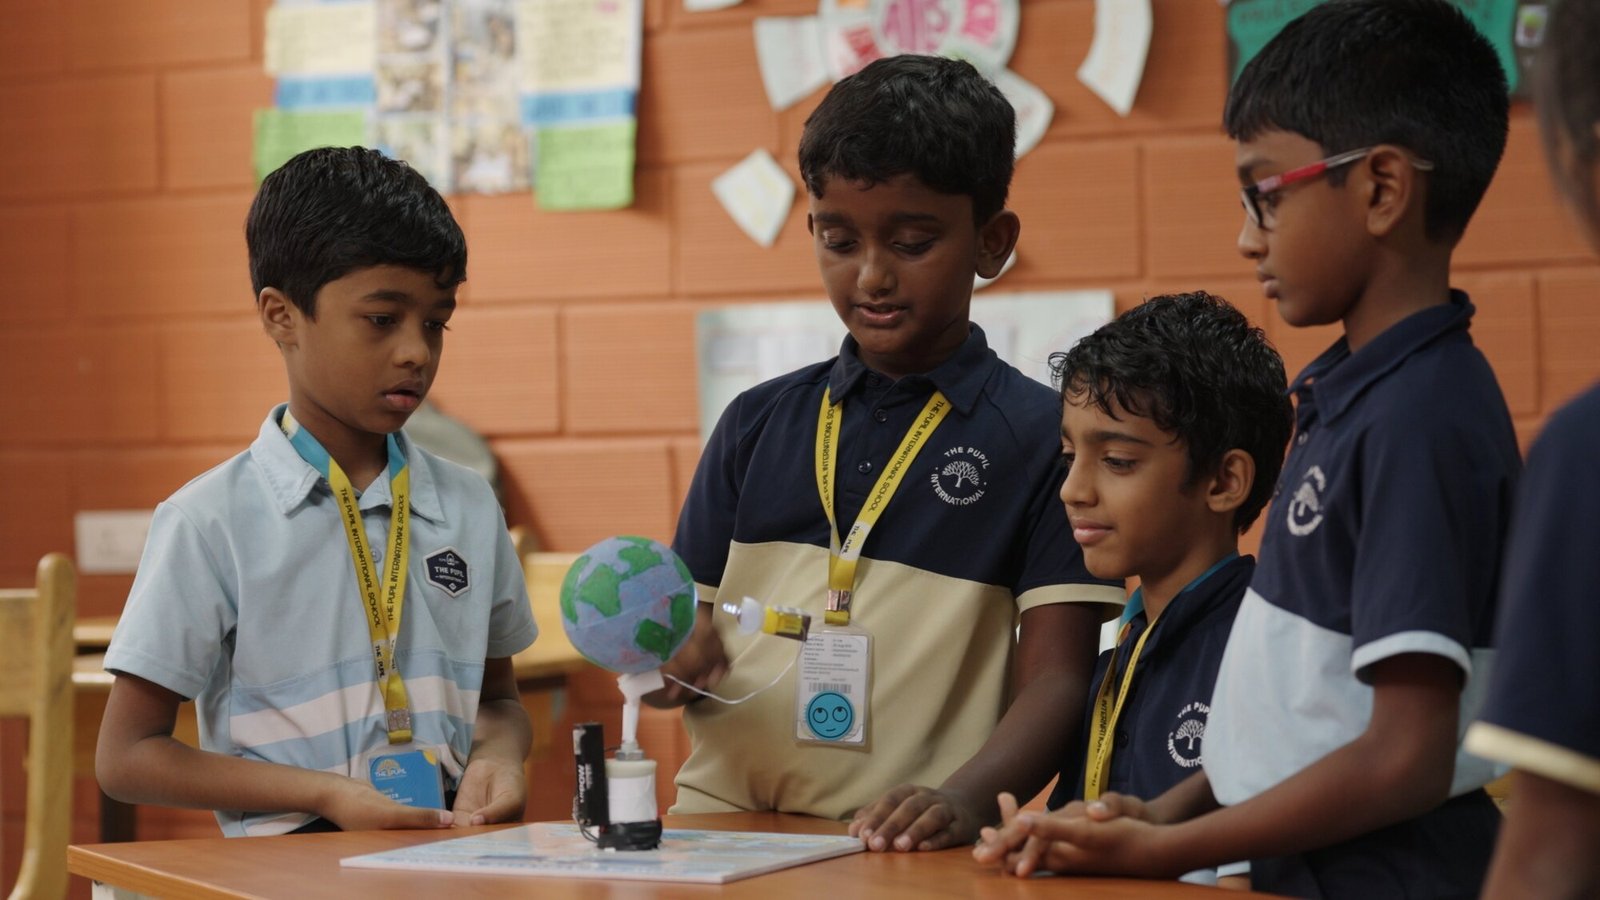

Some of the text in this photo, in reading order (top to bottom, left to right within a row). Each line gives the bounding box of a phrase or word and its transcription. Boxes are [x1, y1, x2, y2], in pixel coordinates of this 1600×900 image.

[931, 400, 945, 414] THE
[886, 429, 922, 481] INTERNATIONAL
[944, 446, 990, 470] THE PUPIL
[867, 481, 890, 513] SCHOOL
[930, 473, 985, 506] INTERNATIONAL
[340, 487, 381, 628] THE PUPIL INTERNATIONAL SCHOOL
[390, 526, 404, 583] INTERNATIONAL
[434, 566, 449, 574] THE
[387, 583, 397, 605] PUPIL
[386, 604, 394, 621] THE
[1177, 704, 1191, 718] THE
